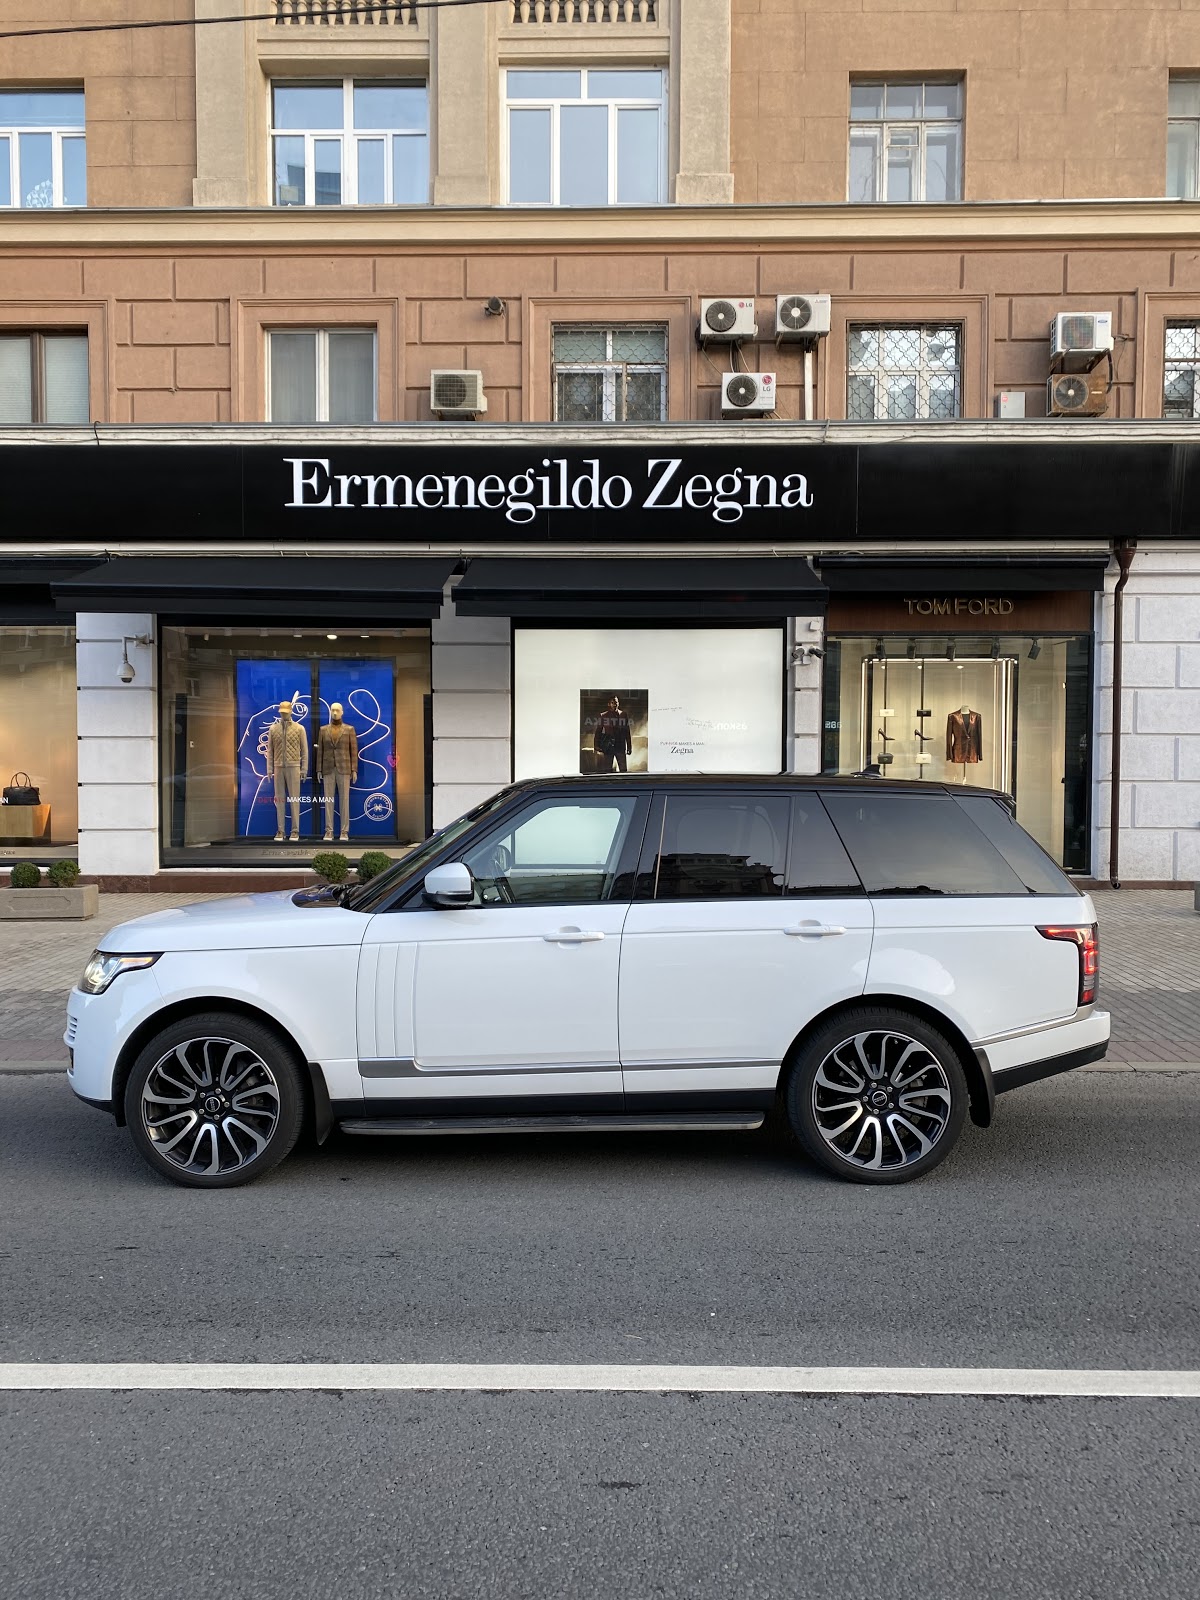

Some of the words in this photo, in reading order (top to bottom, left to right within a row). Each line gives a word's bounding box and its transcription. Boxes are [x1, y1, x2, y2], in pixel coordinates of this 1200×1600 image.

[283, 457, 633, 524] Ermenegildo
[642, 458, 814, 524] Zegna
[903, 598, 951, 615] TOM
[954, 598, 1014, 615] FORD
[670, 746, 694, 755] Zegna
